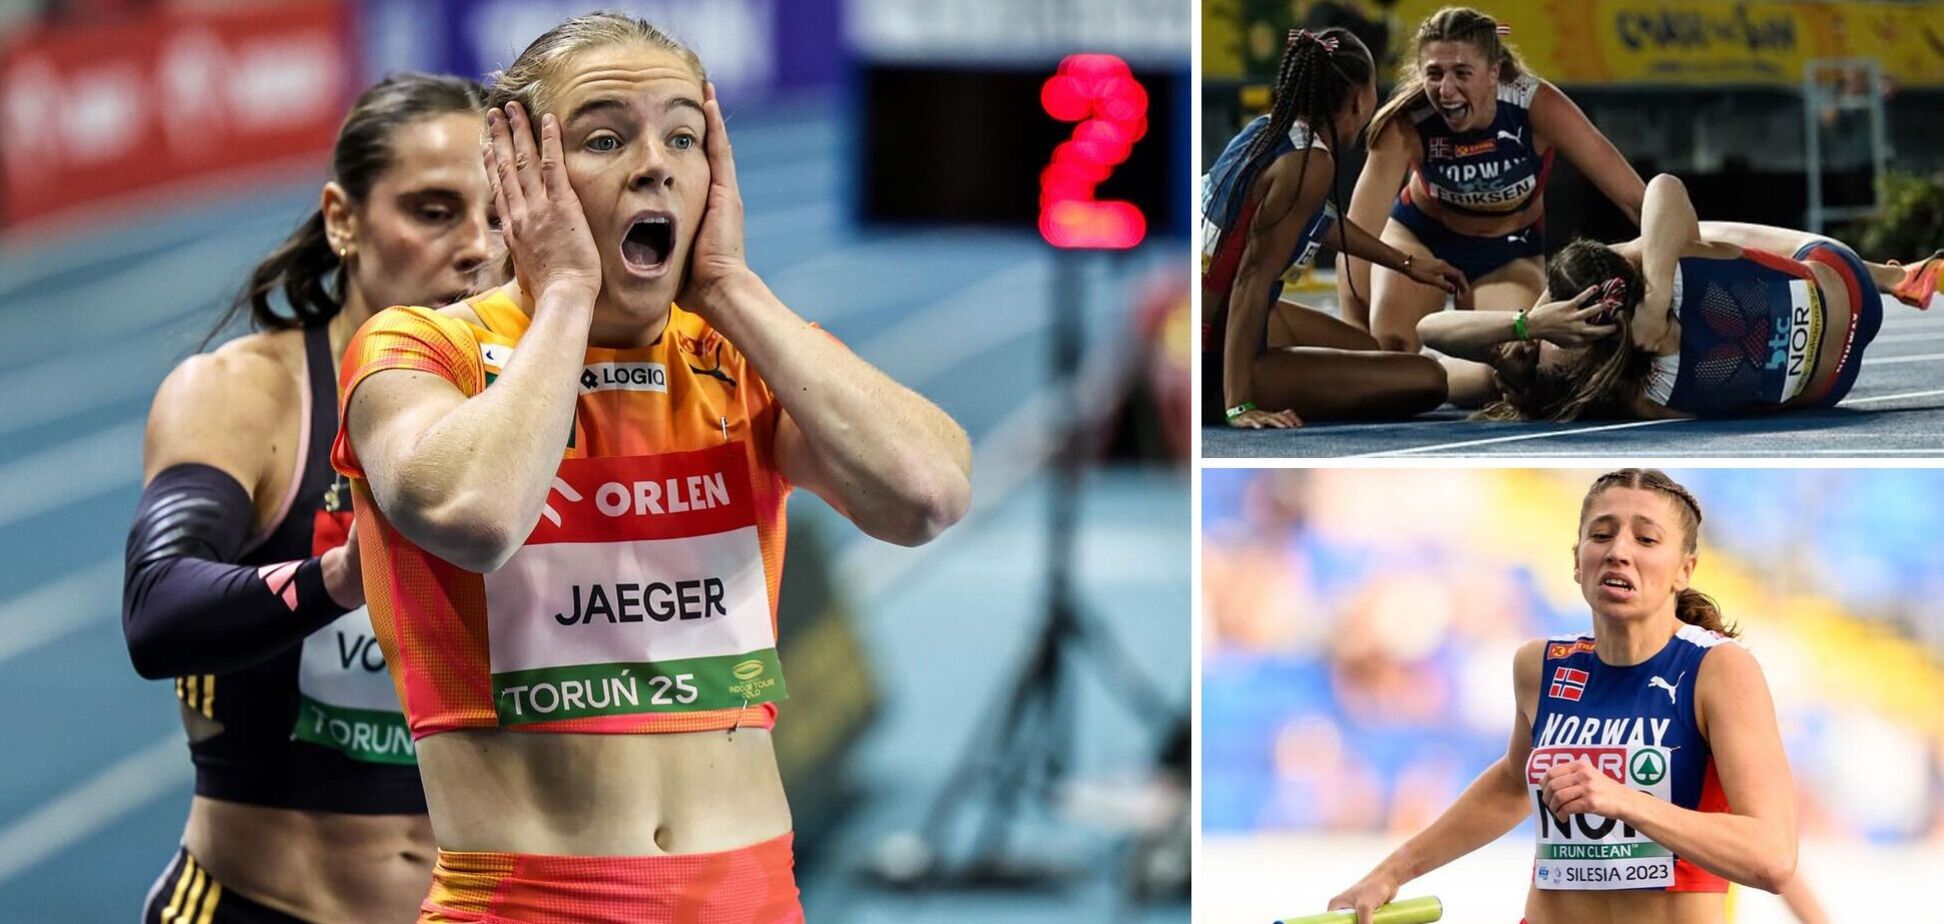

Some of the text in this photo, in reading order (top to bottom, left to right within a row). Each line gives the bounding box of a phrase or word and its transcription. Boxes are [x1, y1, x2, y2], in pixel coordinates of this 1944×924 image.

[1039, 53, 1148, 248] 2
[1437, 180, 1530, 204] ERIKSEN
[1765, 316, 1791, 370] btc
[1789, 307, 1810, 376] NOR
[603, 367, 665, 386] LOGIQ
[595, 472, 731, 518] ORLEN
[555, 577, 727, 626] JAEGER
[504, 669, 698, 715] TORUŃ 25
[1539, 713, 1671, 748] NORWAY
[1561, 846, 1586, 858] RUN
[1566, 866, 1622, 882] SILESIA
[1626, 865, 1668, 880] 2023
